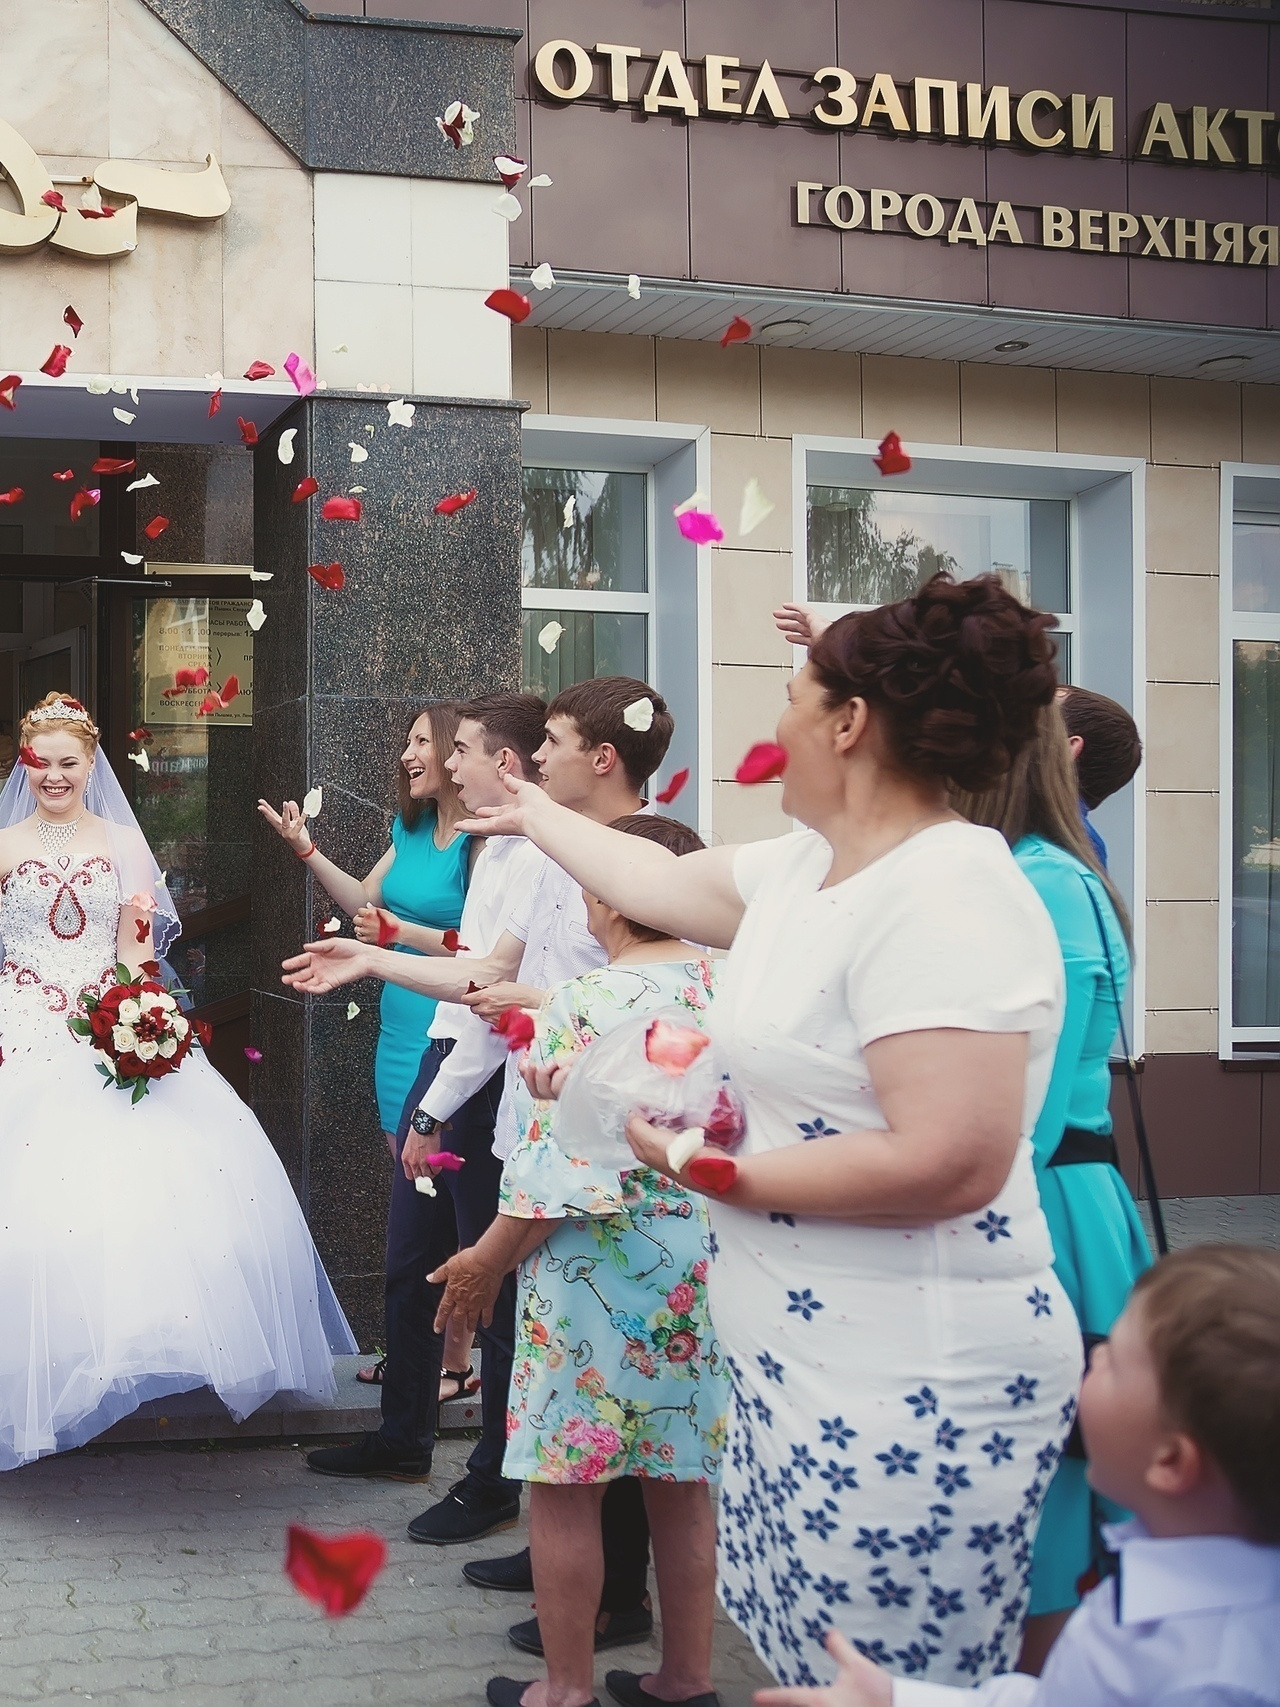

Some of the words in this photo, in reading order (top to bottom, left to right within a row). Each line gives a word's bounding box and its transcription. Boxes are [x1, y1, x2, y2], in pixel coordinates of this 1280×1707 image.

[535, 39, 790, 119] ОТДЕЛ
[813, 67, 1113, 152] ЗАПИСИ
[1141, 102, 1280, 165] АКТ
[797, 181, 1023, 246] ГОРОДА
[1042, 205, 1279, 266] ВЕРХНЯЯ
[159, 627, 178, 635] 8.00
